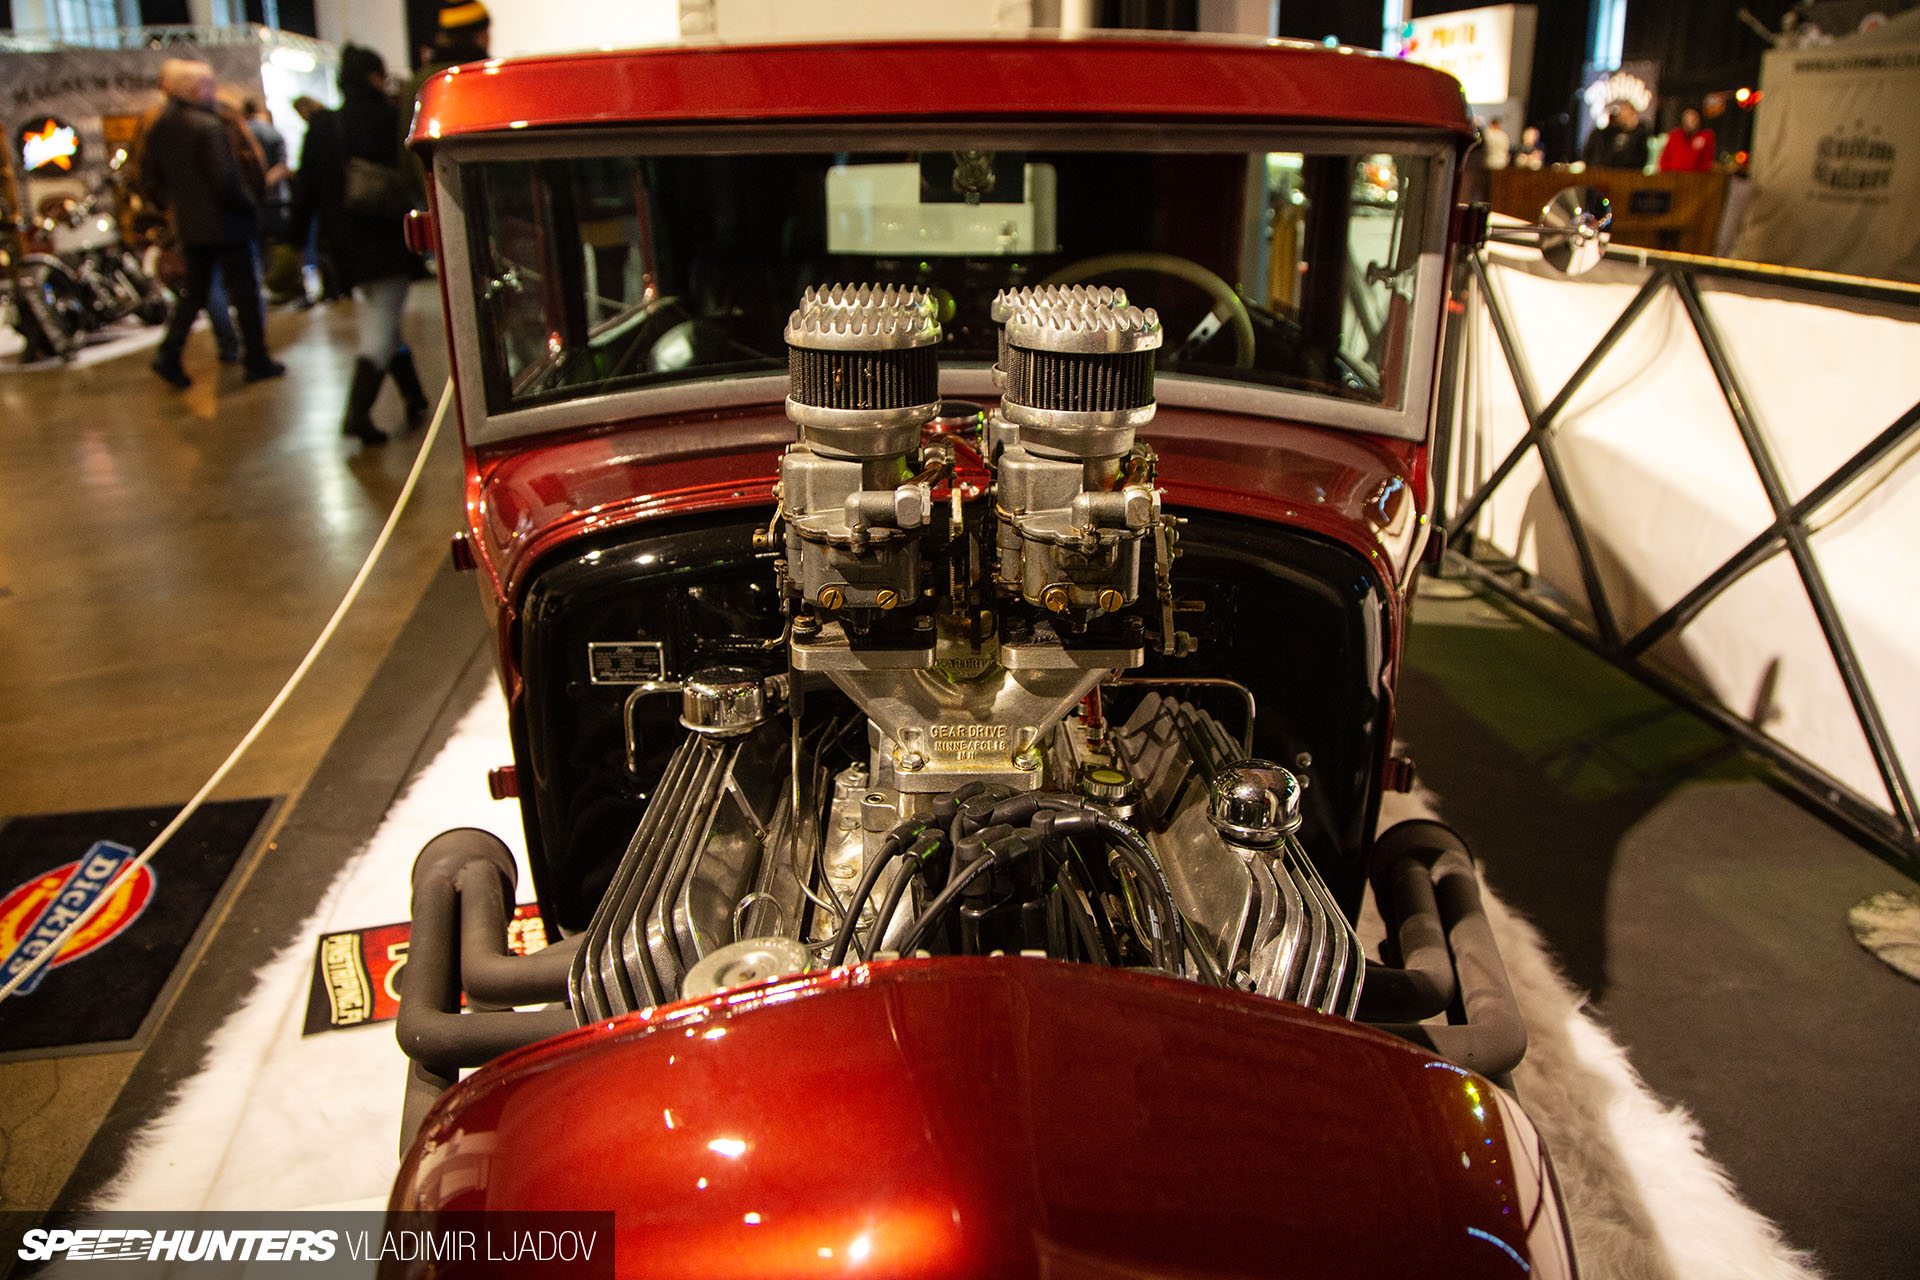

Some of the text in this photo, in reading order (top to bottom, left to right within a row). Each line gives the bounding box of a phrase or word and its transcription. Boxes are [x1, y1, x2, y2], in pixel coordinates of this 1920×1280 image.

[930, 725, 1008, 738] GEAR DRIVE
[934, 740, 1009, 751] MINNEAPOLIS
[1108, 819, 1132, 836] MSD
